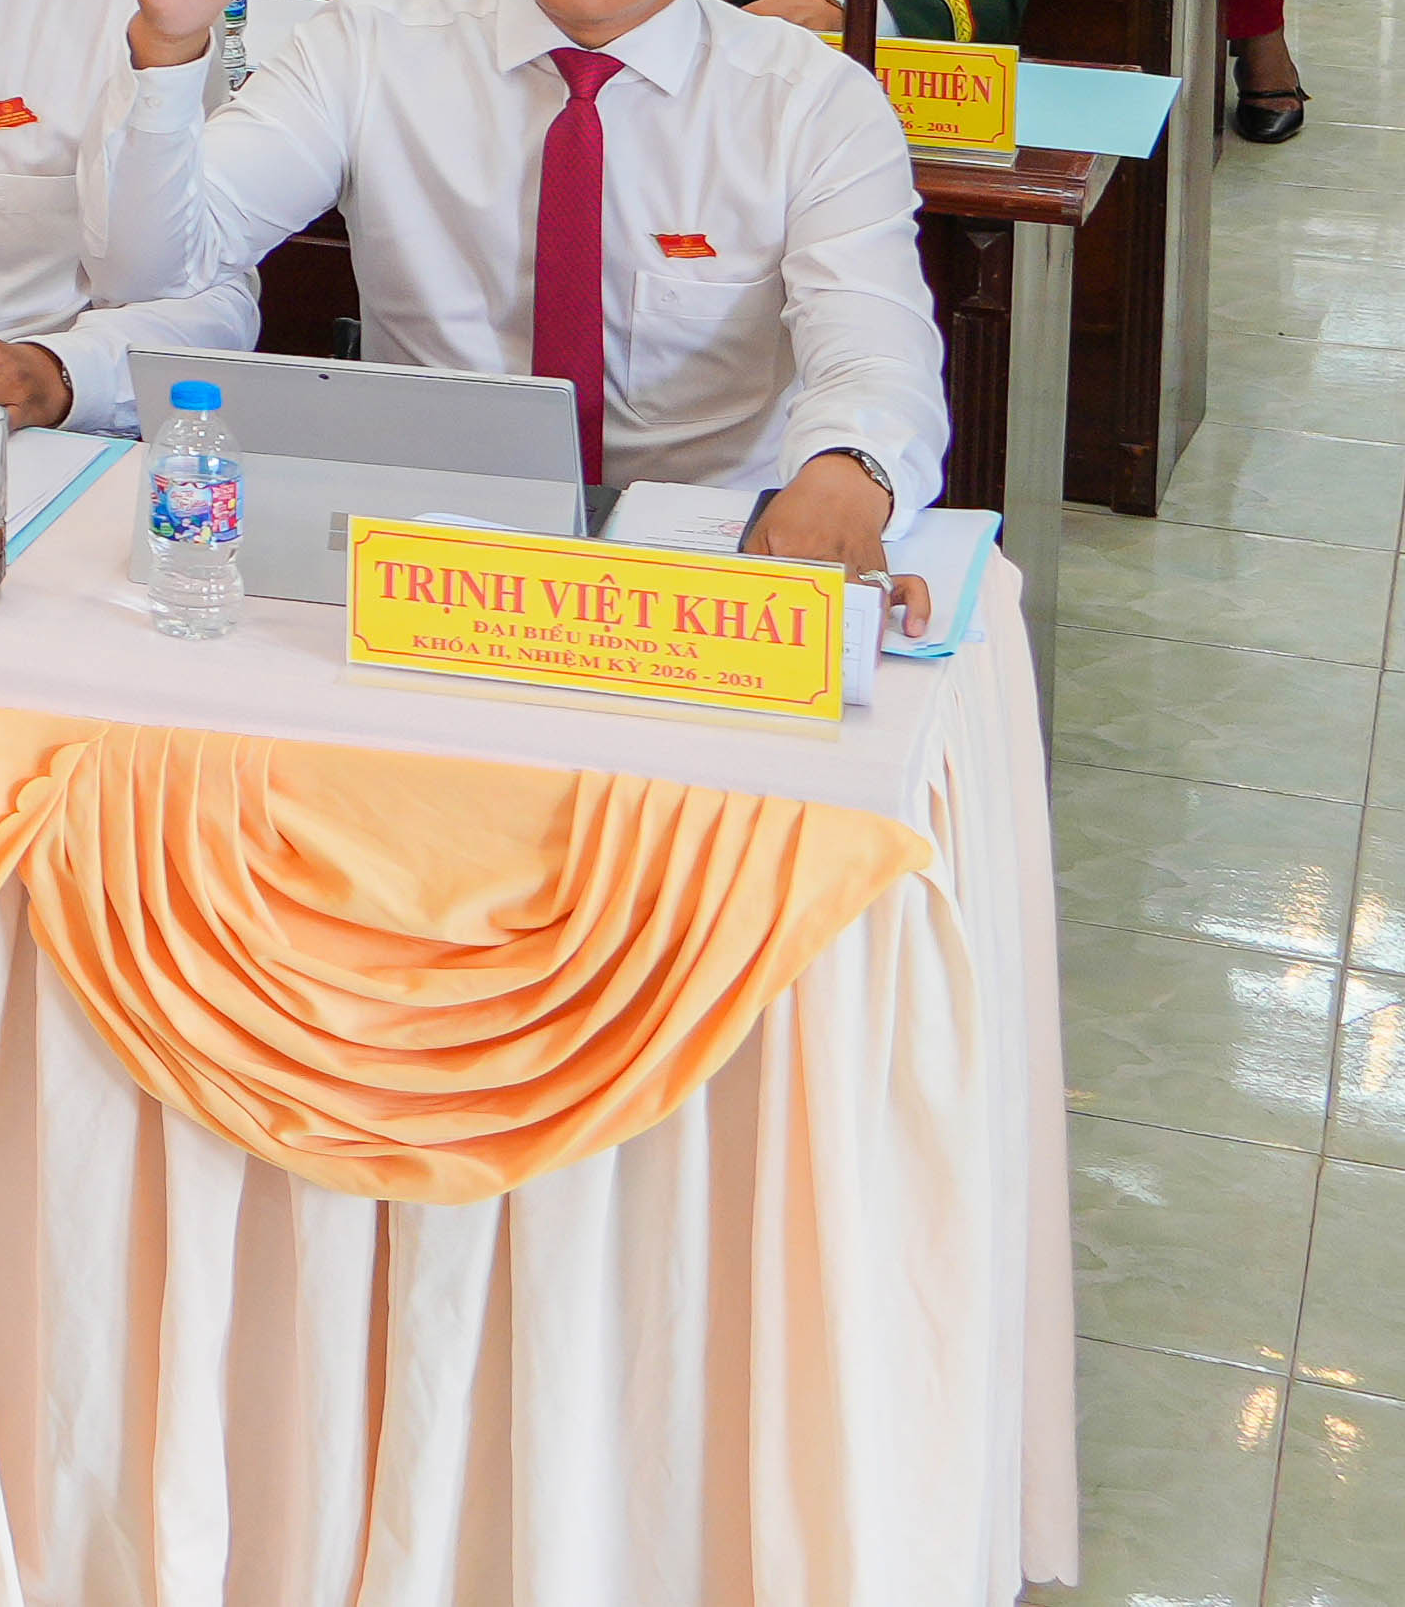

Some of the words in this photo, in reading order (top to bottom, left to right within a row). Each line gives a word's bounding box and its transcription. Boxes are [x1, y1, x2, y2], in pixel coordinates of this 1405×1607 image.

[898, 65, 992, 107] THIỆN
[928, 122, 960, 134] 2031
[375, 561, 525, 615] TRỊNH
[540, 573, 659, 633] VIỆT
[672, 592, 809, 647] KHÁI
[474, 620, 518, 639] ĐẠI
[524, 624, 581, 645] BIỂU
[589, 634, 658, 654] HĐND
[665, 641, 700, 660] XÃ
[412, 635, 480, 655] KHÓA
[488, 643, 512, 660] II,
[518, 648, 601, 671] NHIỆM
[607, 657, 642, 675] KỲ
[649, 663, 697, 682] 2026
[717, 671, 764, 690] 2031
